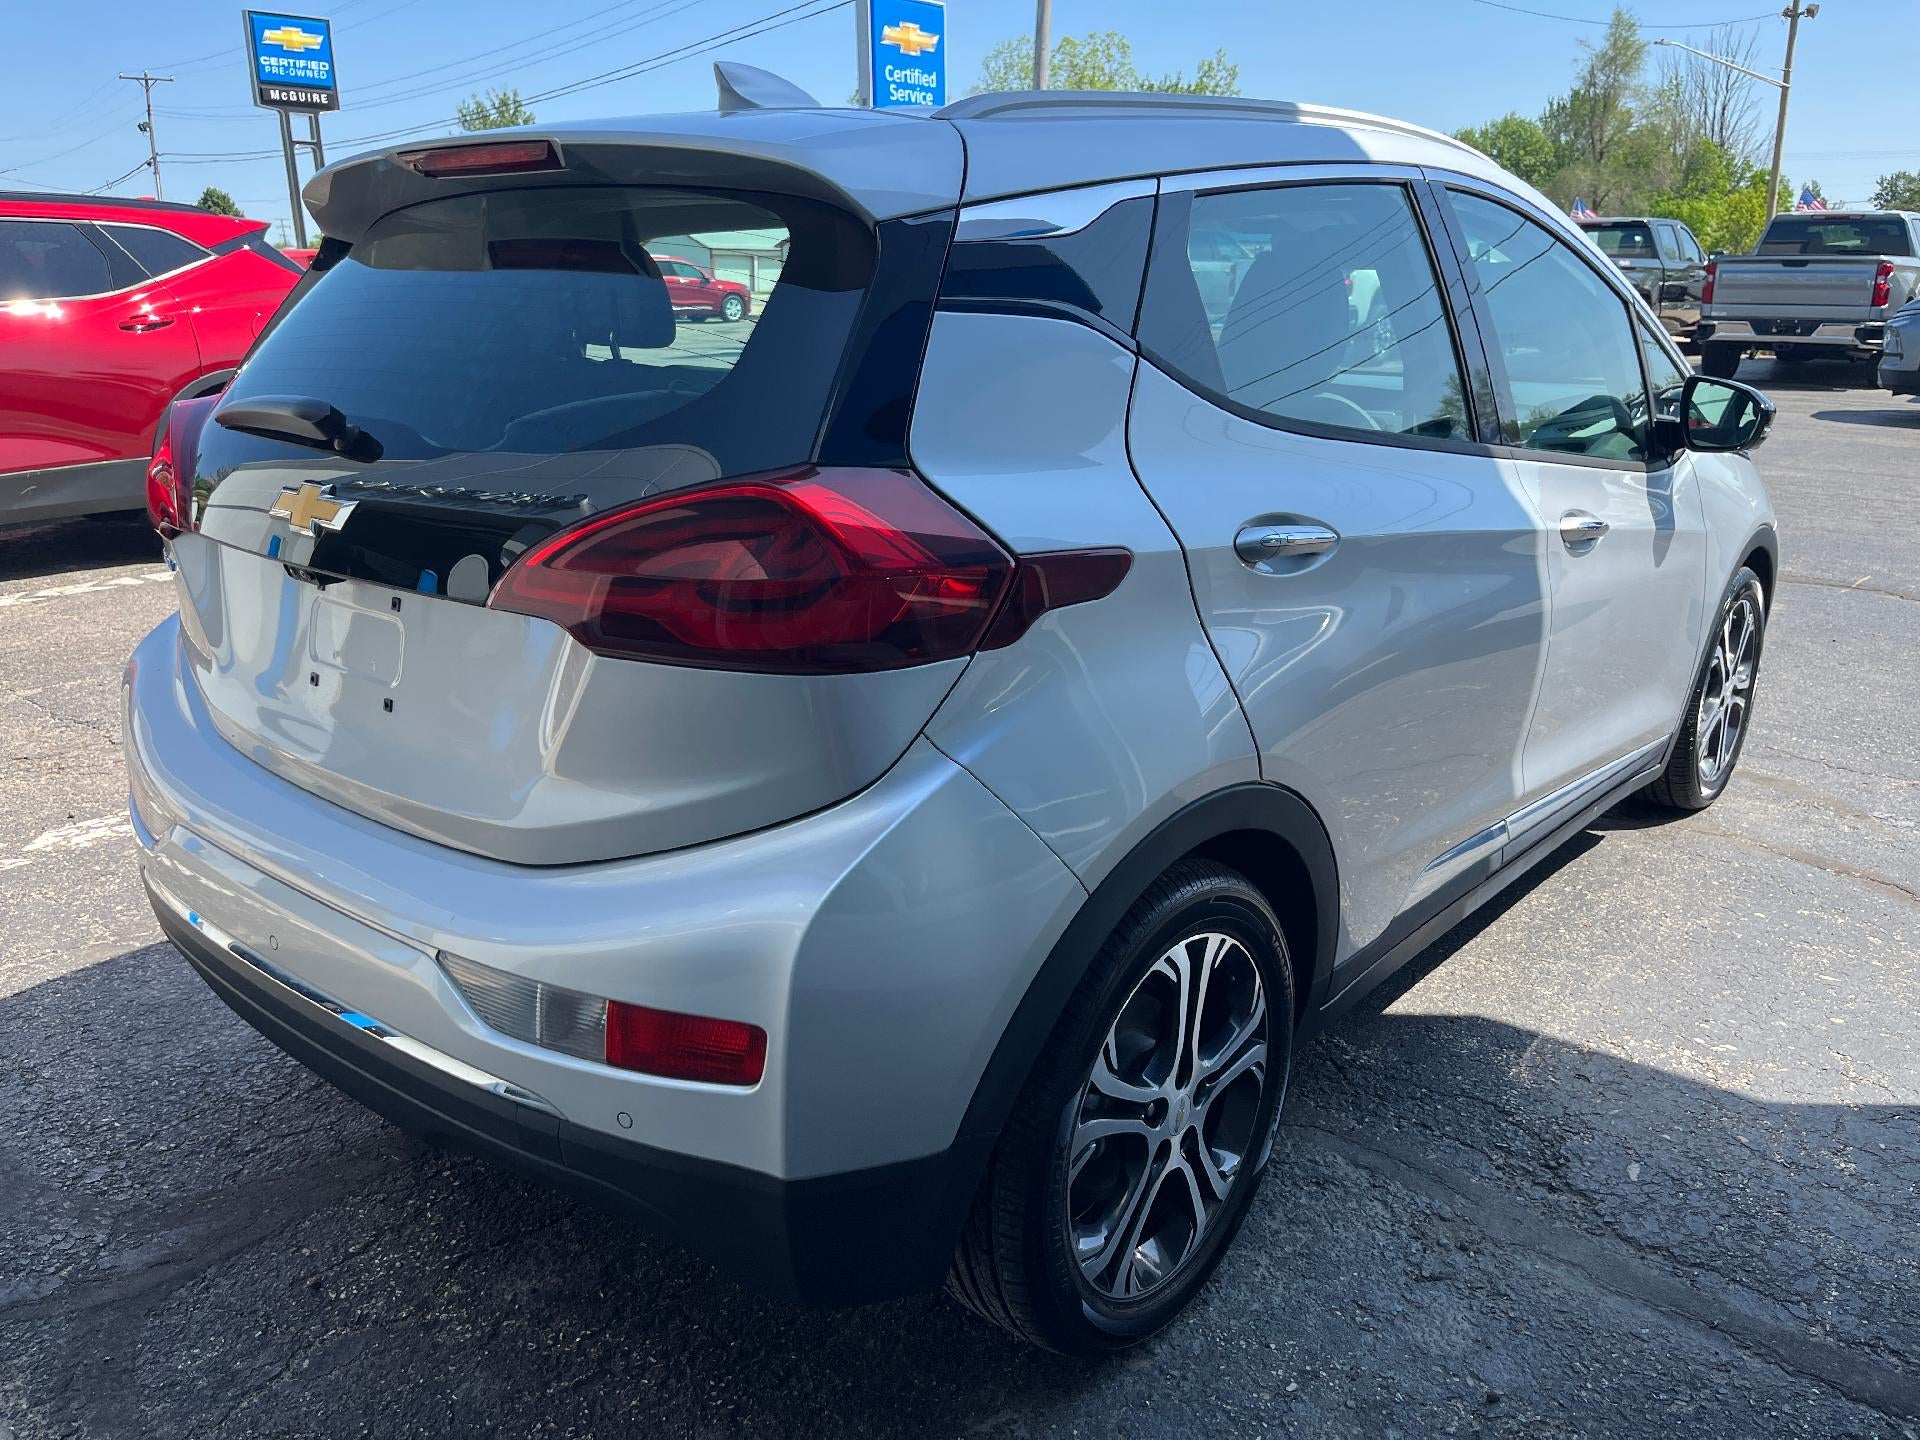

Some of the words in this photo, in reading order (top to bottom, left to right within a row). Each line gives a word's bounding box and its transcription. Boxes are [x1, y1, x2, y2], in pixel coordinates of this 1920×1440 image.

[260, 56, 329, 71] CERTIFIED
[265, 65, 327, 79] PRE-OWNED
[885, 65, 937, 88] Certified
[889, 84, 934, 106] Service
